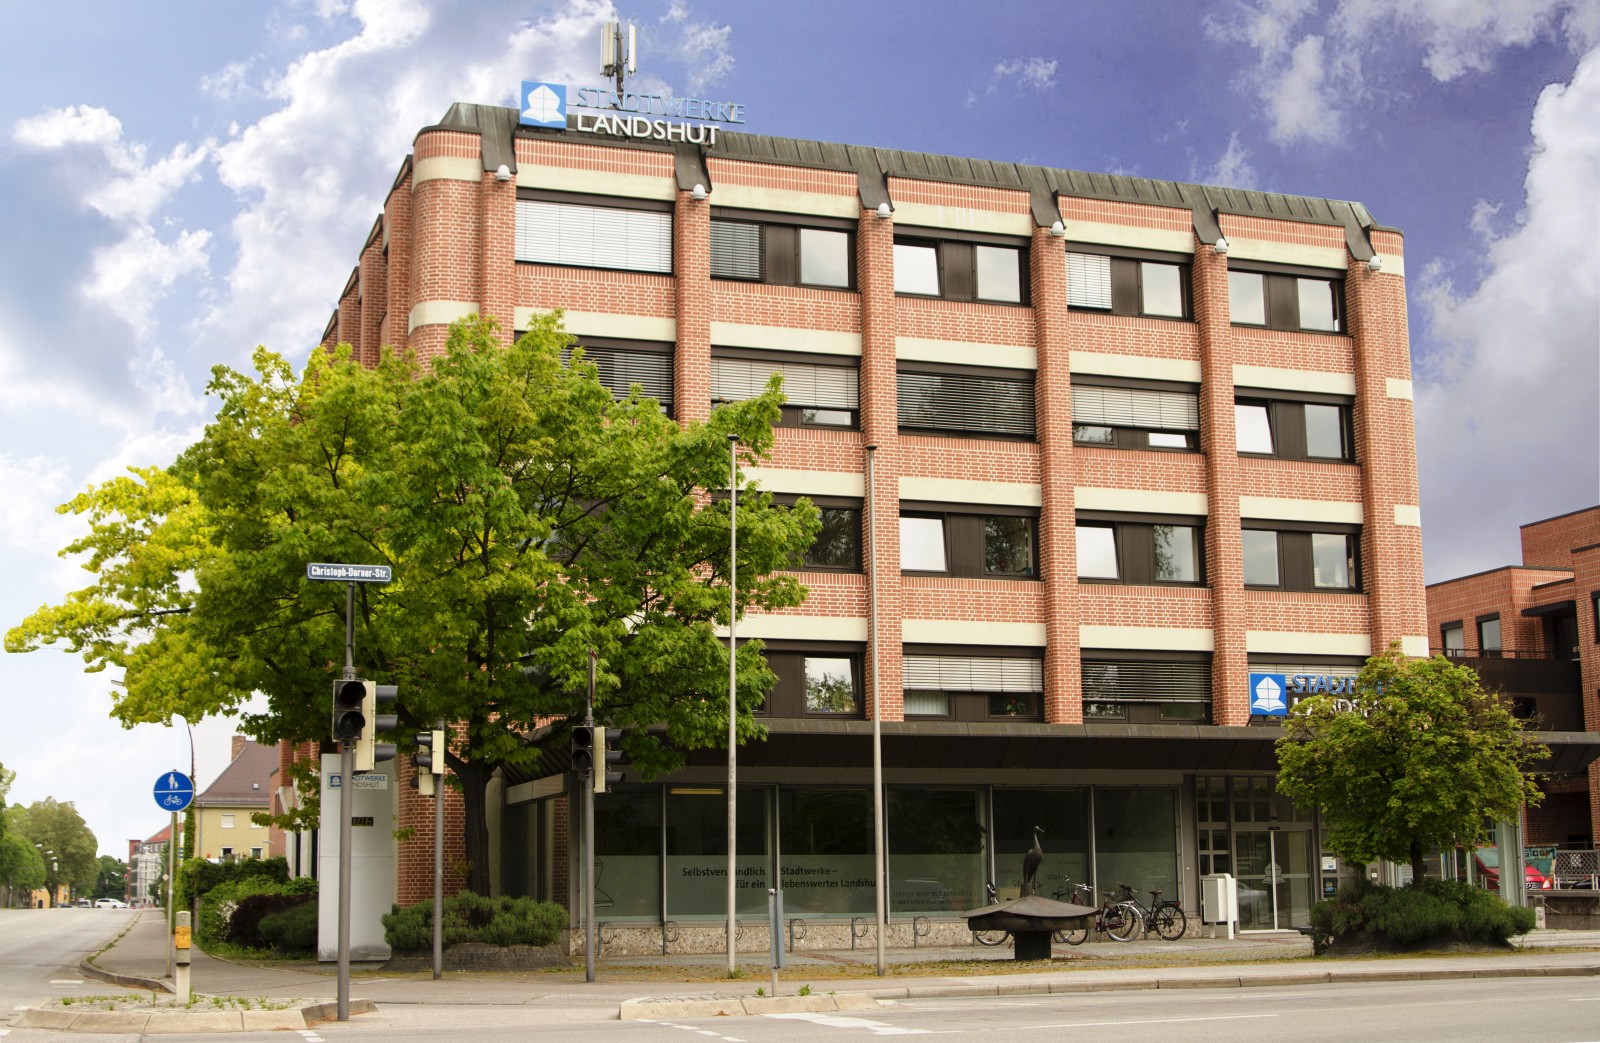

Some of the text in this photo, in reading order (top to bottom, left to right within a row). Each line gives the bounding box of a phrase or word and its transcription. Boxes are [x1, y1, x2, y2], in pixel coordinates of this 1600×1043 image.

[576, 87, 746, 124] STADTWERKE
[576, 113, 720, 145] LANDSHUT
[311, 566, 388, 578] Christoph-Dorner-Str.
[682, 866, 766, 877] Selbstversndlich
[780, 866, 831, 876] Stadtwerke
[735, 879, 877, 889] für ein lebenswertes Landshu
